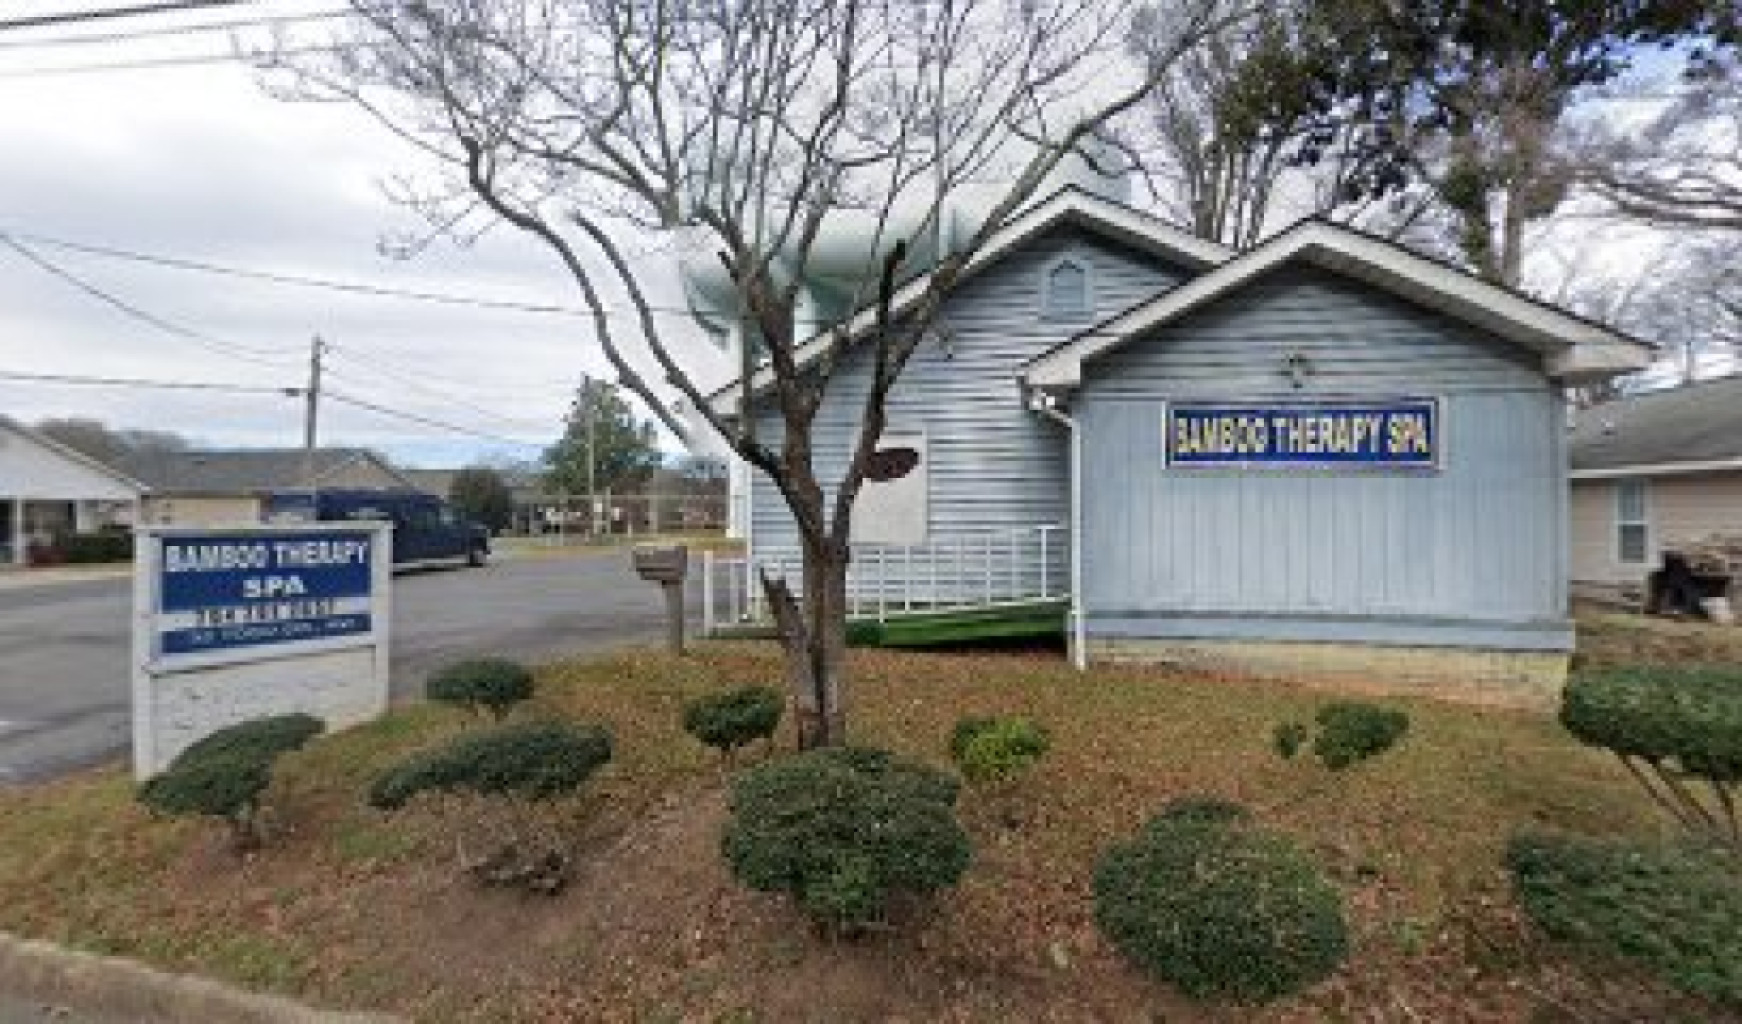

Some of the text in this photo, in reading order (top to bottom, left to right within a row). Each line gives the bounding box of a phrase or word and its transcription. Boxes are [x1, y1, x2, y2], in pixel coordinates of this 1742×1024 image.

[1175, 412, 1428, 453] BAMBOO THERAPY SPA
[165, 539, 369, 573] BAMBOO THERAPY
[242, 574, 306, 598] SPA
